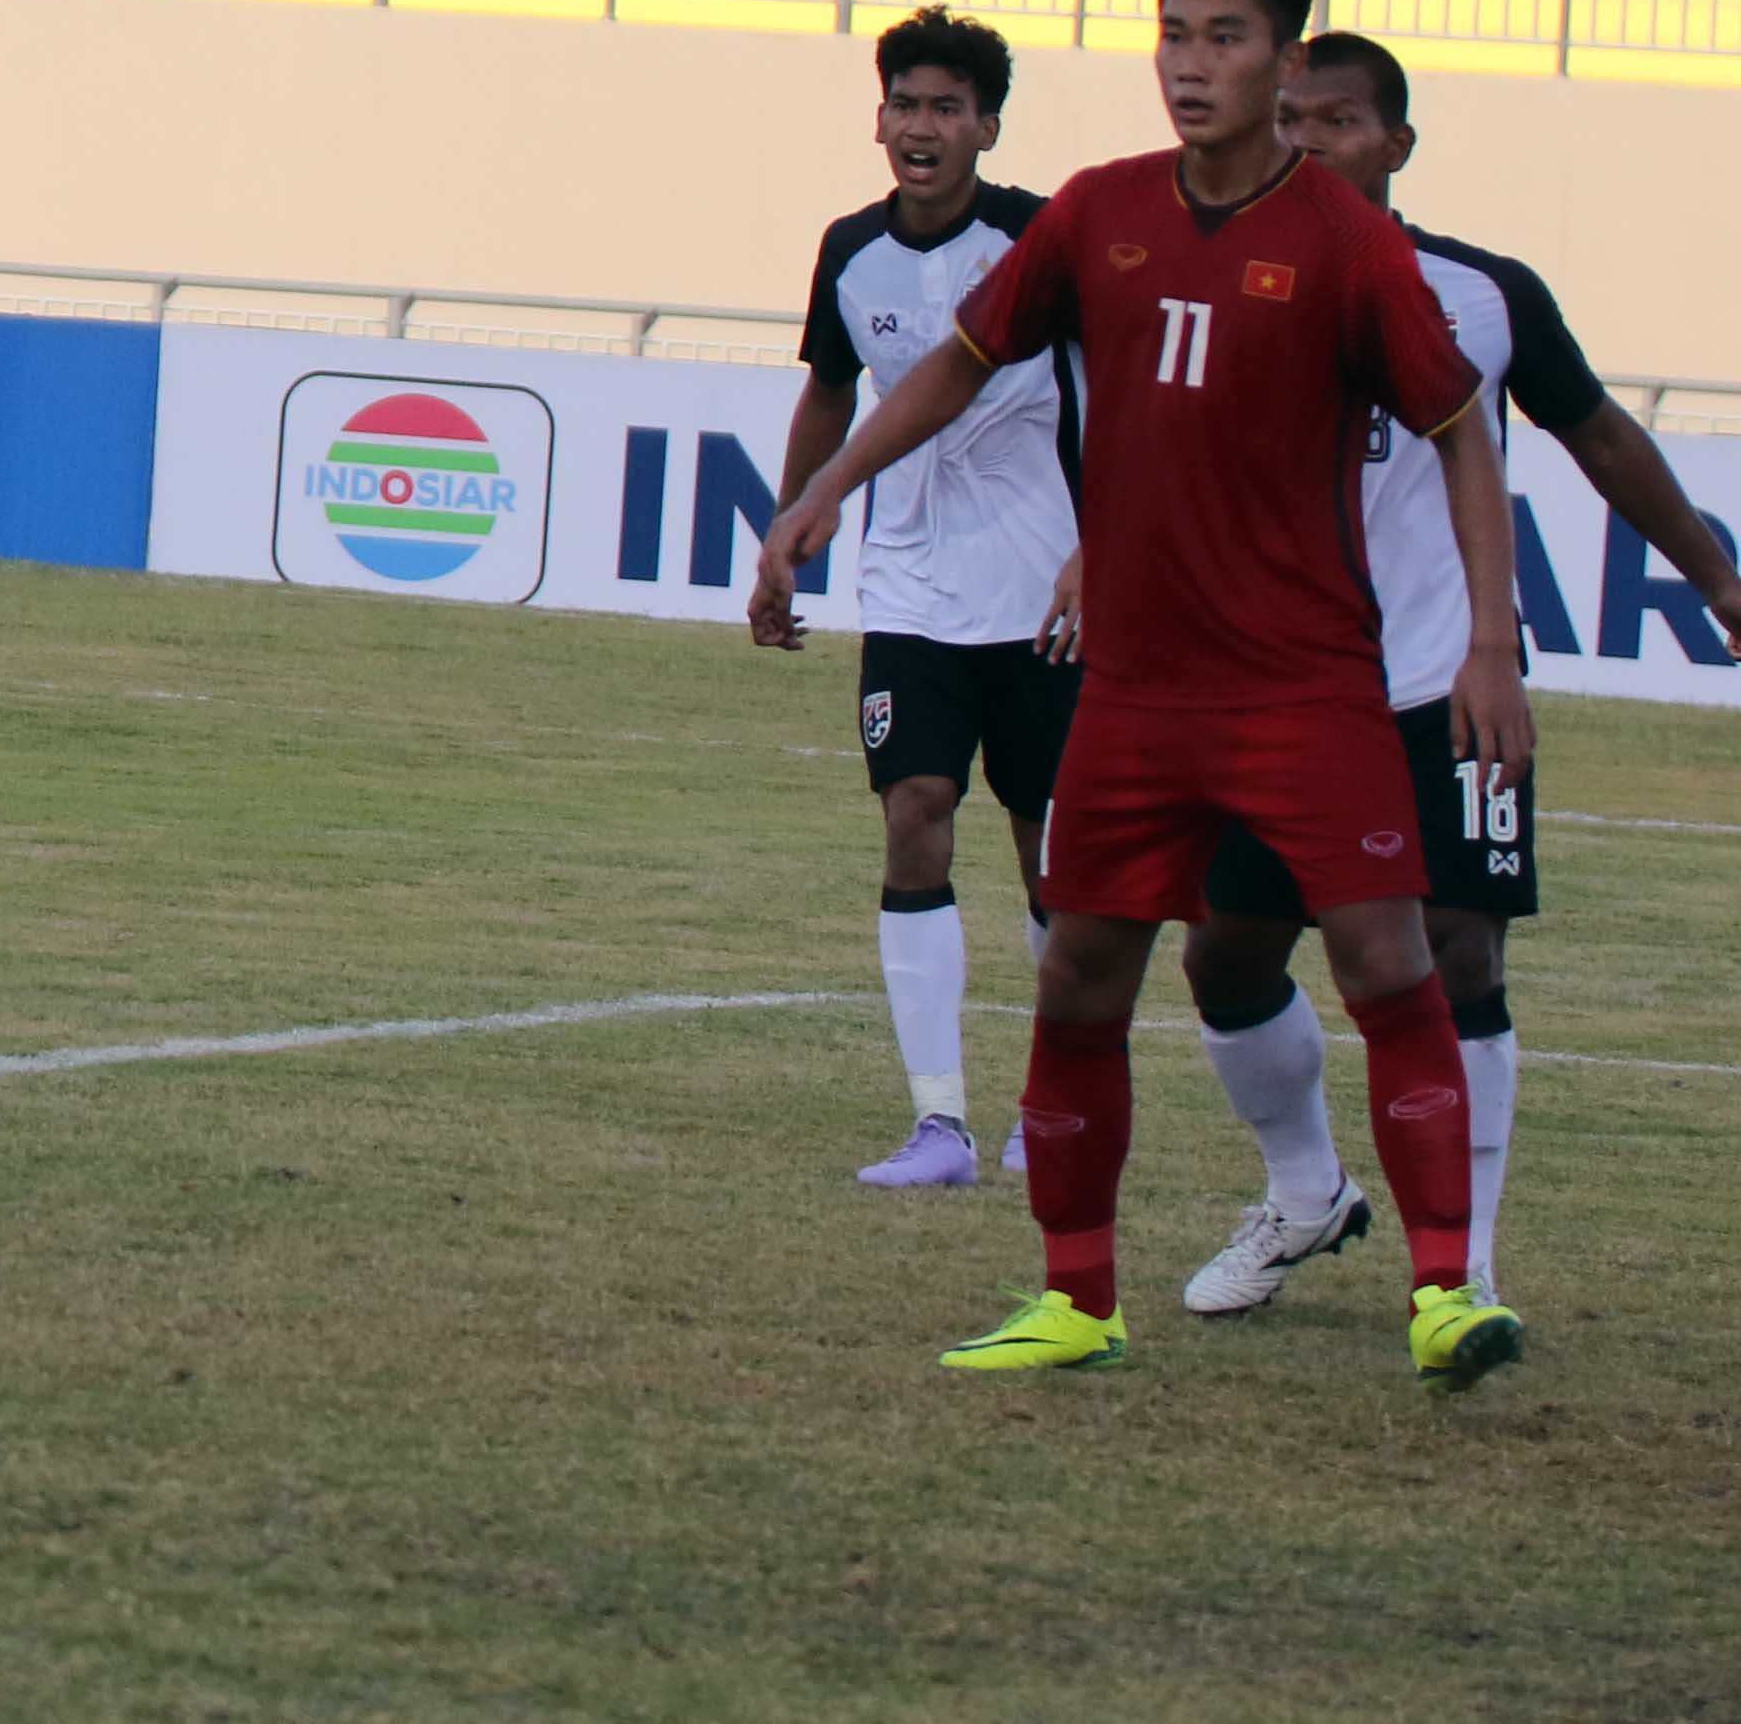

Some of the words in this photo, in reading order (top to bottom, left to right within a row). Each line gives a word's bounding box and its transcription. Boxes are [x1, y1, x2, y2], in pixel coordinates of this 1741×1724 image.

[1157, 297, 1213, 389] 11
[304, 465, 516, 514] INDOSIAR
[1454, 759, 1518, 842] 18
